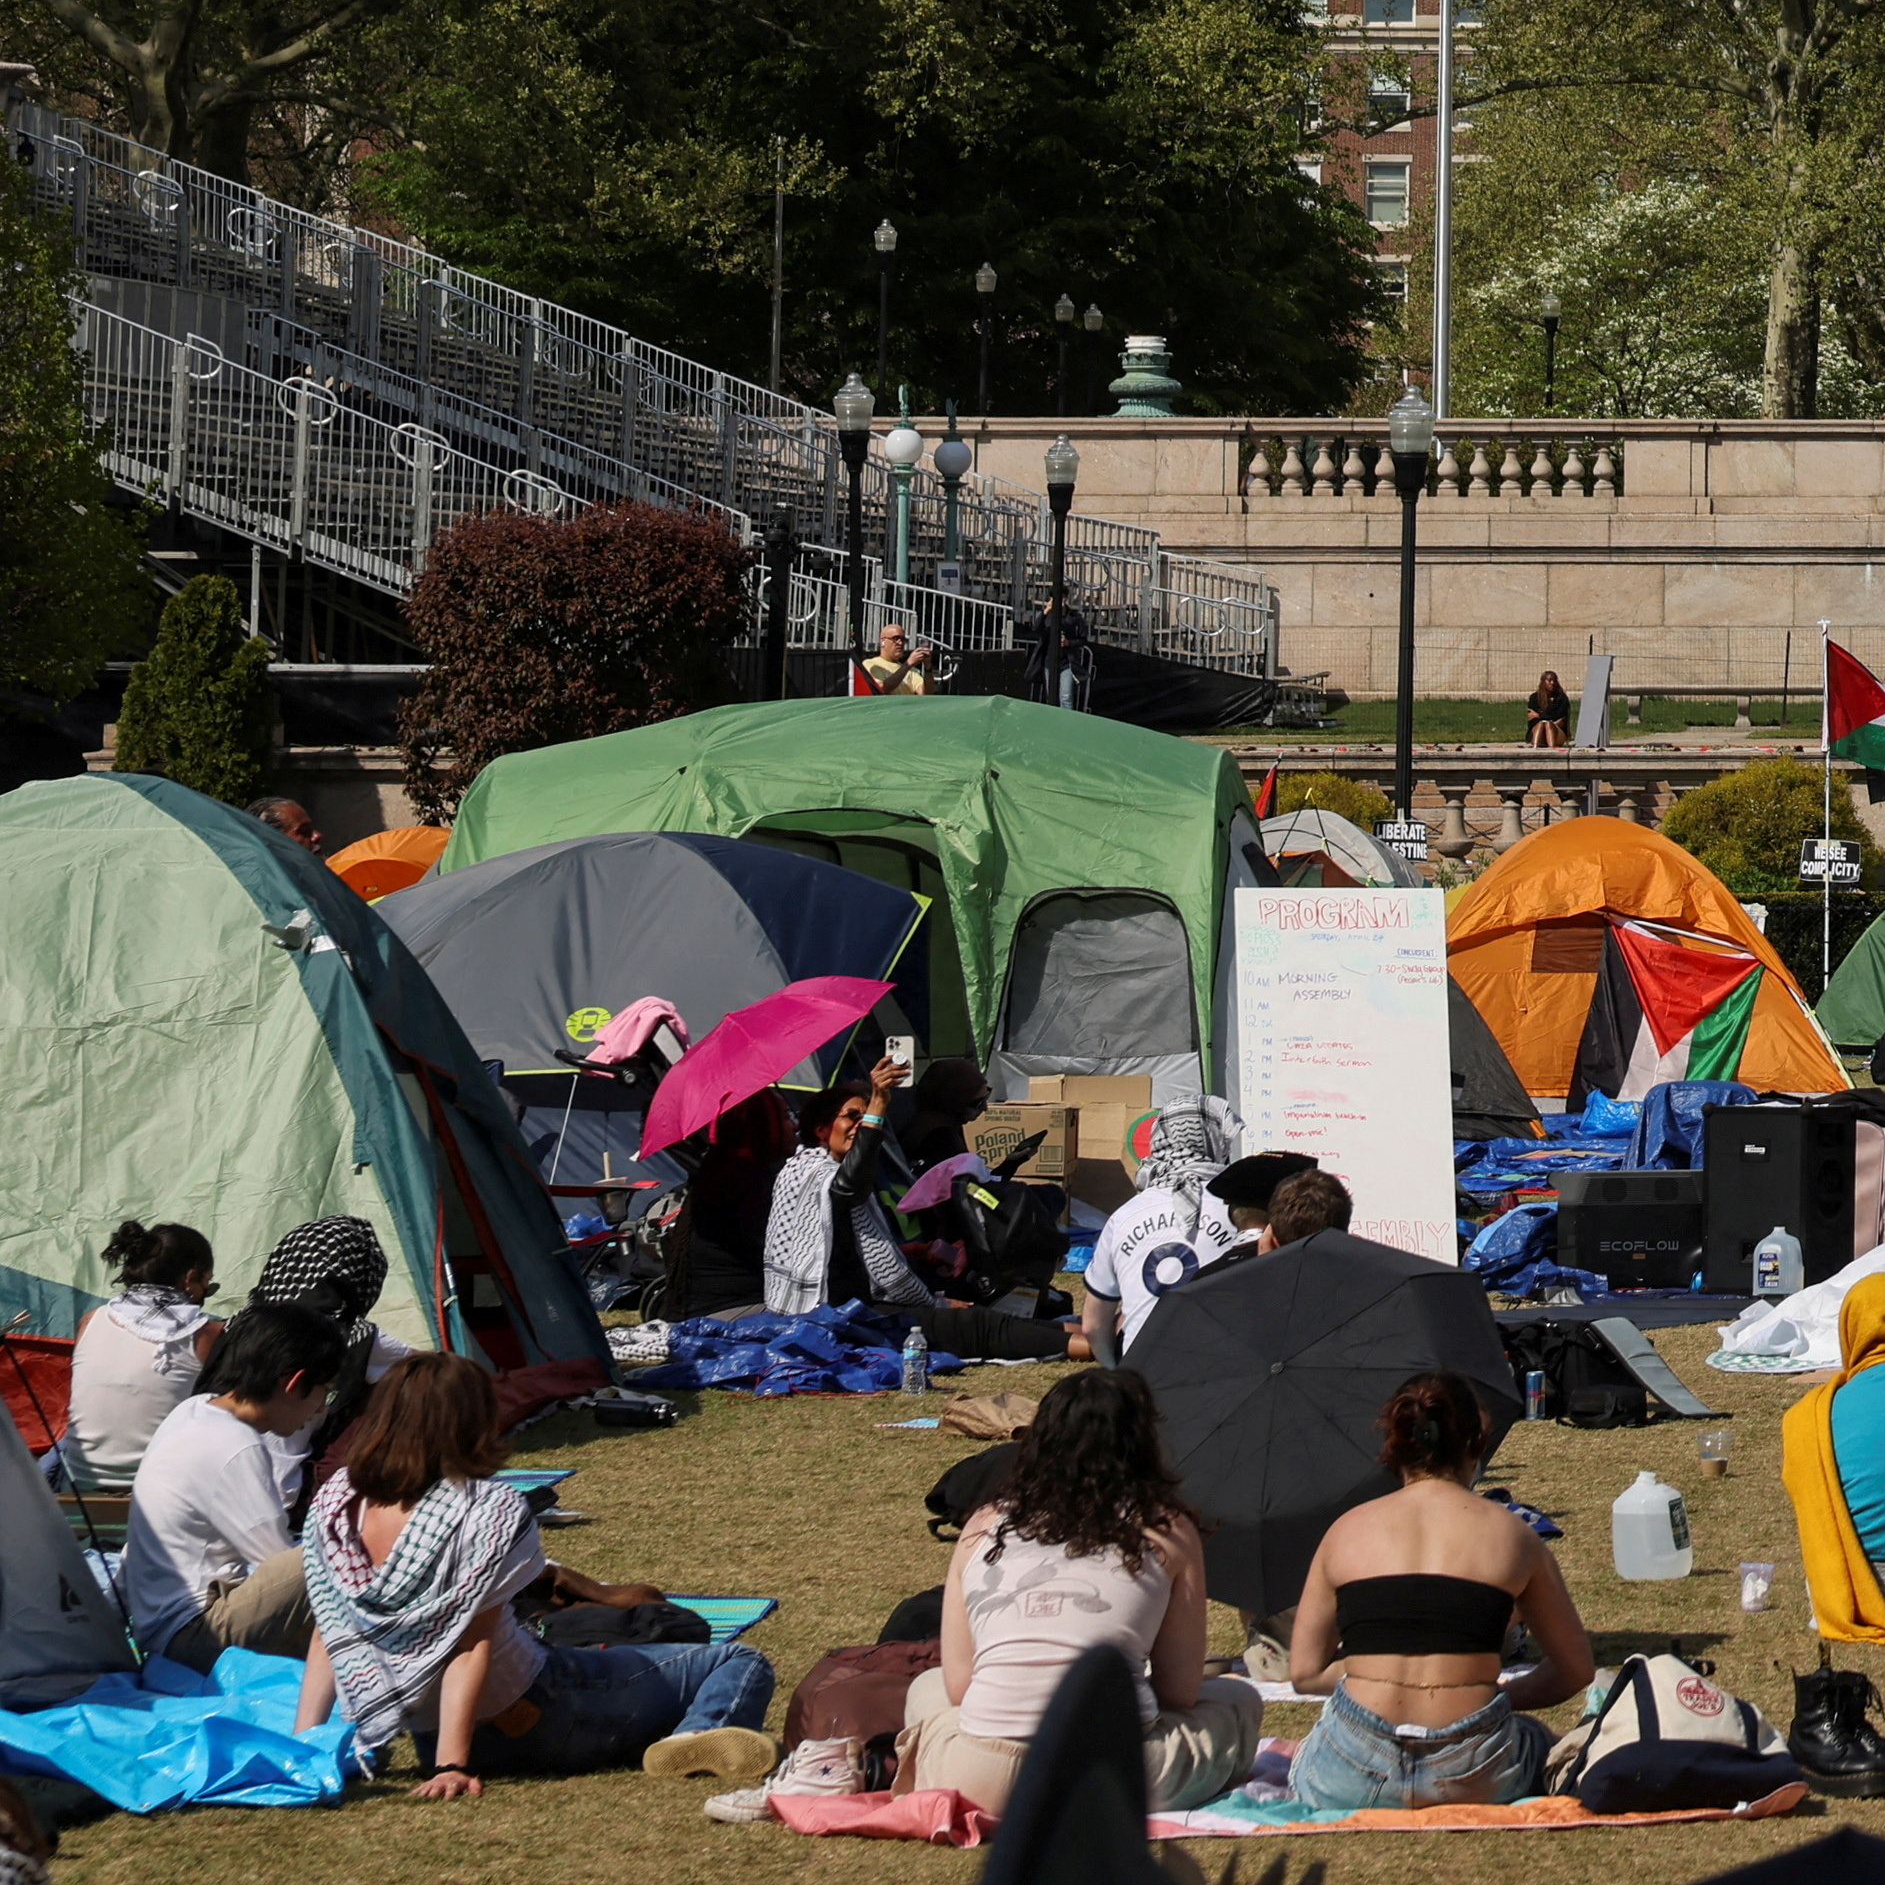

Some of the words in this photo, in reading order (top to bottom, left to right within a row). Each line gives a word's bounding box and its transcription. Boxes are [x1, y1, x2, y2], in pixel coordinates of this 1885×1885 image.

[1376, 823, 1427, 841] LIBERATE
[1814, 845, 1826, 860] WE
[1829, 846, 1847, 861] SEE
[1258, 896, 1410, 931] PROGRAM
[1243, 970, 1255, 986] 10
[1256, 977, 1270, 987] AM
[1278, 971, 1339, 985] MORNING
[1293, 989, 1352, 1001] ASSEMBLY
[1244, 999, 1254, 1010] 11
[1256, 1001, 1270, 1011] AM
[1244, 1014, 1258, 1028] 12
[1261, 1037, 1273, 1046] PM
[1244, 1049, 1256, 1064] 2
[1261, 1054, 1273, 1064] PM
[1244, 1066, 1254, 1080] 3
[1261, 1072, 1272, 1080] PM
[1243, 1084, 1252, 1097] 4
[1260, 1089, 1272, 1097] PM
[1261, 1129, 1273, 1139] PM
[1599, 1240, 1680, 1252] ECOFLOW
